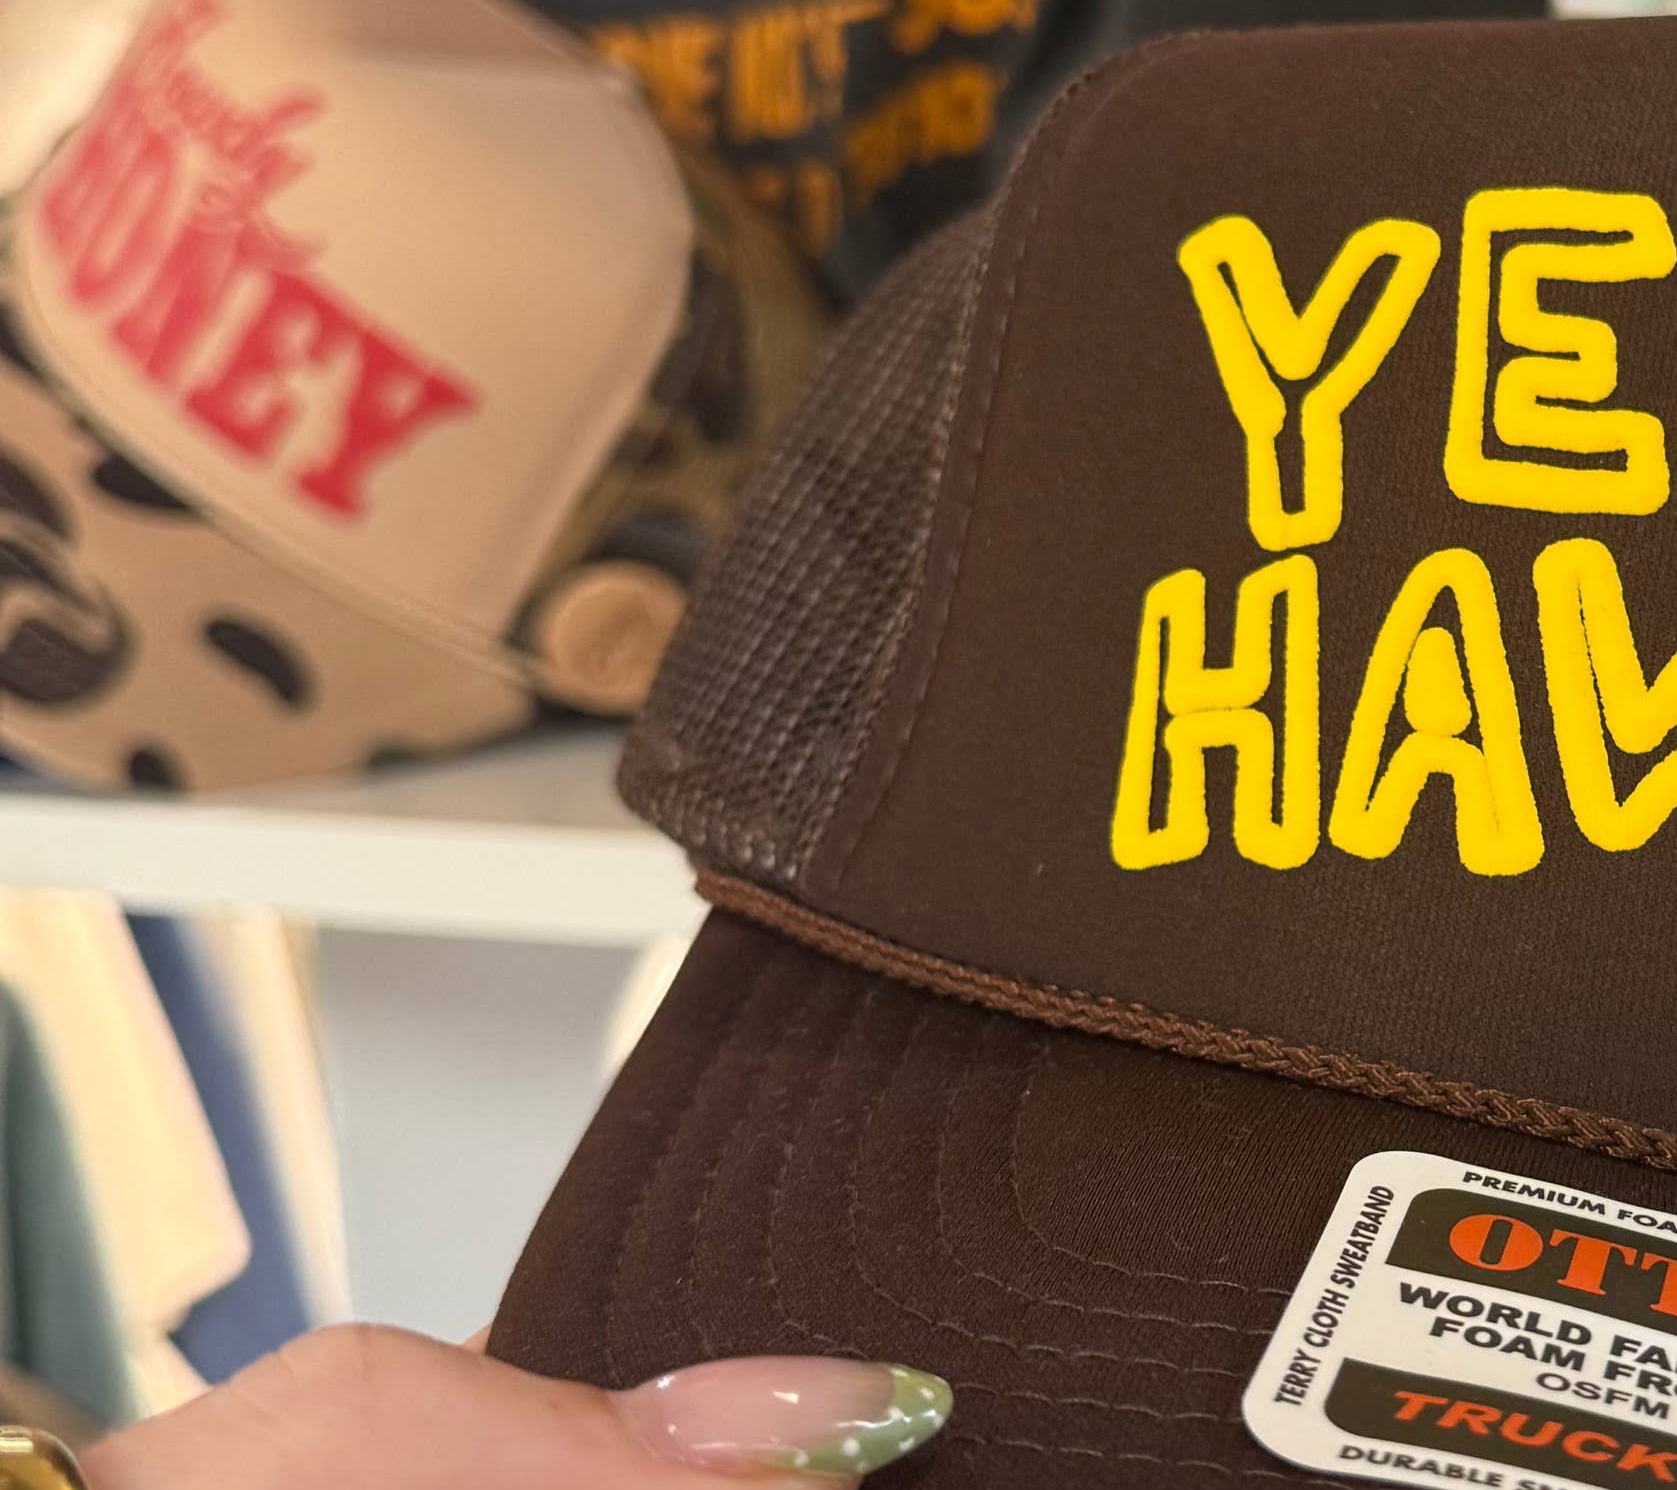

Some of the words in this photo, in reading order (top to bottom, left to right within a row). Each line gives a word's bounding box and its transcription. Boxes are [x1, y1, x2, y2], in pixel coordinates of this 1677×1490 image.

[38, 109, 482, 521] HONEY
[1461, 1170, 1606, 1216] PREMIUM
[1273, 1346, 1322, 1407] TERRY
[1302, 1288, 1350, 1349] CLOTH
[1329, 1184, 1395, 1289] SWEATBAND
[1398, 1281, 1593, 1346] WORLD
[1429, 1315, 1588, 1372] FOAM
[1535, 1371, 1672, 1421] OSFM
[1338, 1444, 1506, 1488] DURABLE
